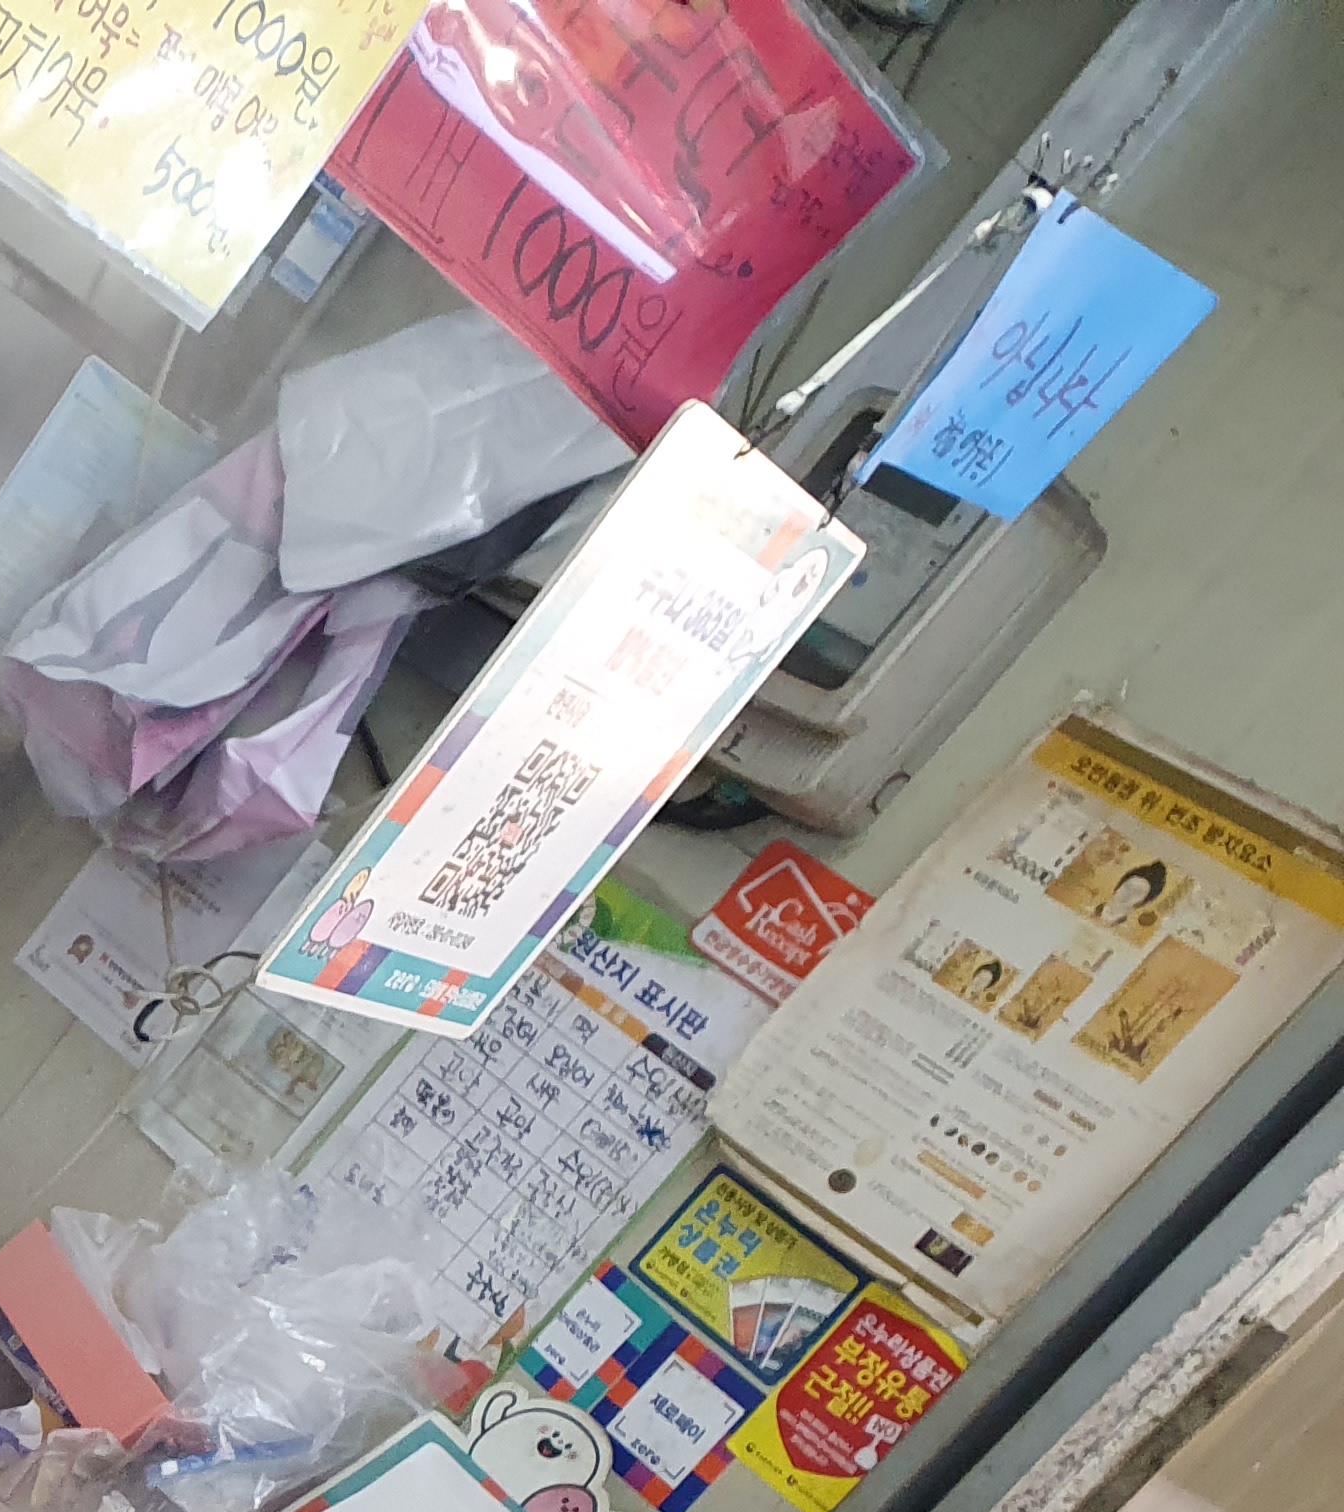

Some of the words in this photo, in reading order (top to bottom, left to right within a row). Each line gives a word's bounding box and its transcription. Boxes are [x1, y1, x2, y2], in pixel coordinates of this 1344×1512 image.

[473, 174, 683, 412] 1000원
[772, 895, 819, 947] Cash
[567, 928, 642, 991] 원산지
[632, 975, 712, 1044] 표시판
[541, 1041, 600, 1091] 오징어
[674, 1220, 743, 1281] 상품권
[693, 1197, 765, 1257] 온누리
[834, 1332, 933, 1422] 부정유통
[852, 1310, 955, 1394] 온누리상품권
[647, 1391, 708, 1446] 제로페이
[801, 1363, 875, 1426] 근절!!
[628, 1437, 663, 1467] zero
[871, 1418, 898, 1438] NO
